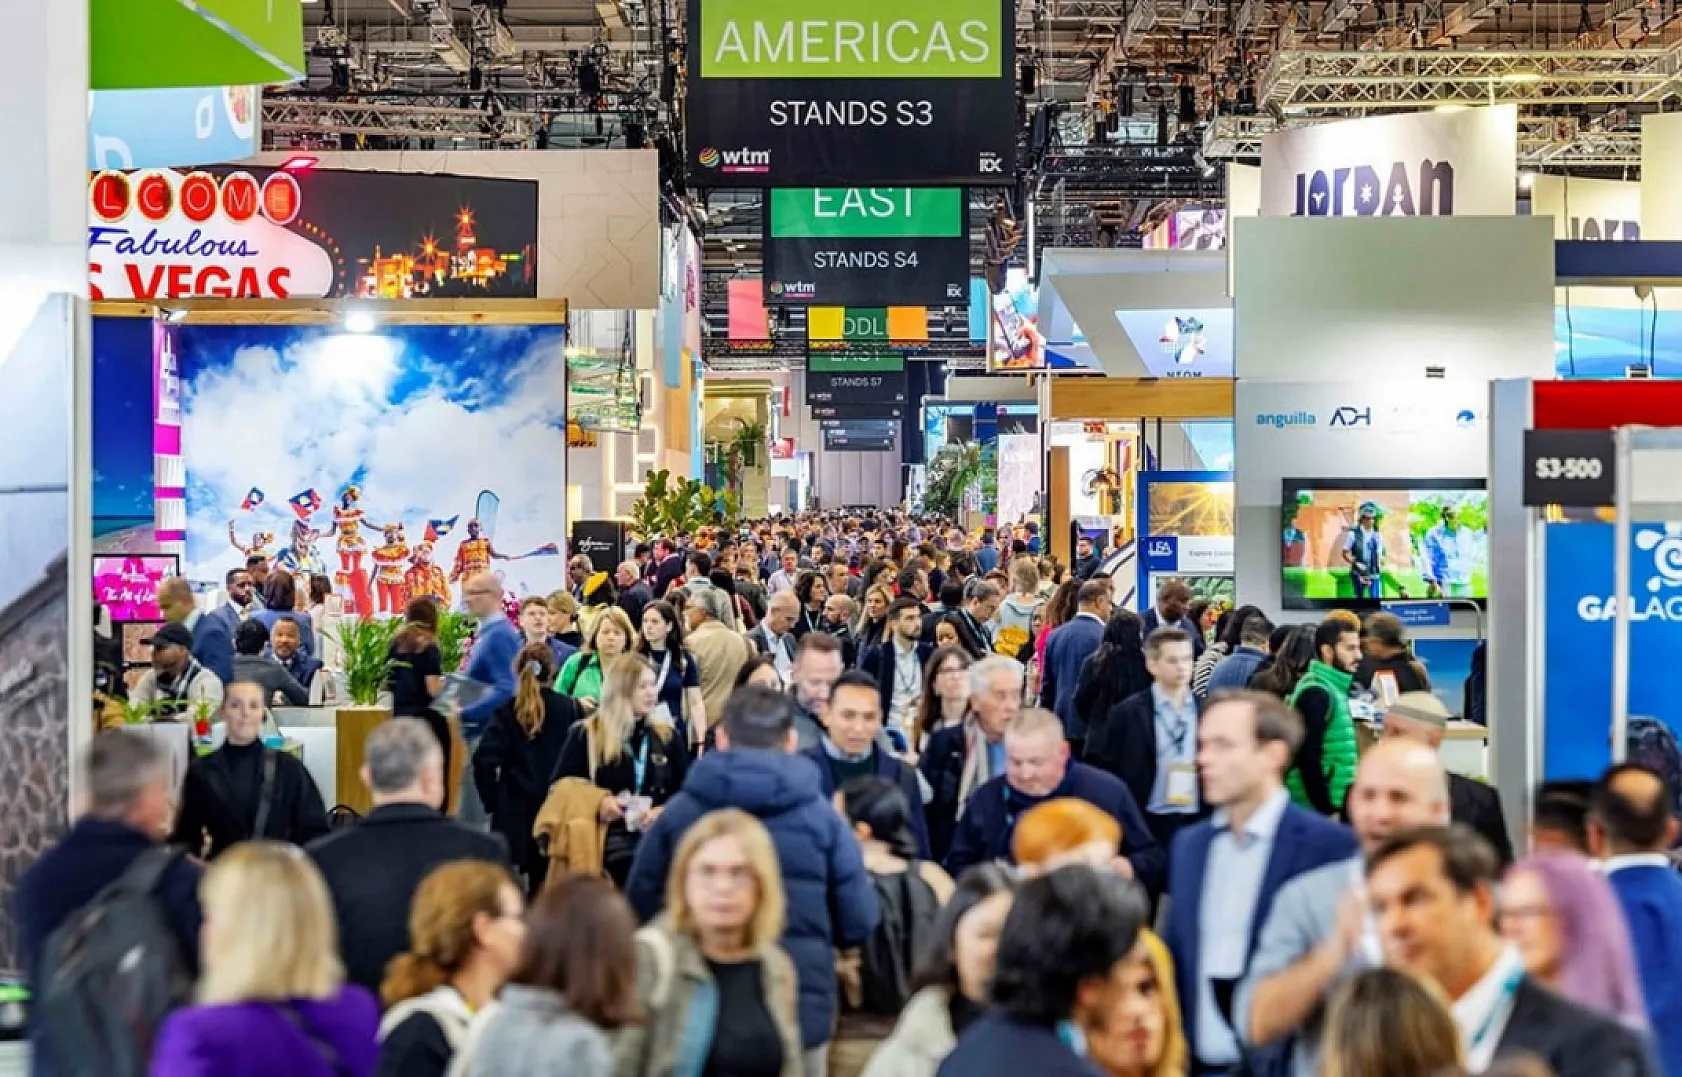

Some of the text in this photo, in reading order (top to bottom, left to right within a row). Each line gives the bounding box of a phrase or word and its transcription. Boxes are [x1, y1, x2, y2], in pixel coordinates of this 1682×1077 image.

[714, 20, 991, 63] AMERICAS
[769, 101, 934, 125] STANDS S3
[722, 147, 769, 165] wtm
[814, 187, 912, 217] EAST
[88, 227, 258, 256] Fabulous
[814, 250, 919, 268] STANDS S4
[124, 264, 292, 299] VEGAS
[830, 377, 882, 387] STANDS S7
[1256, 411, 1317, 428] anguilla
[1535, 456, 1603, 479] S3-500
